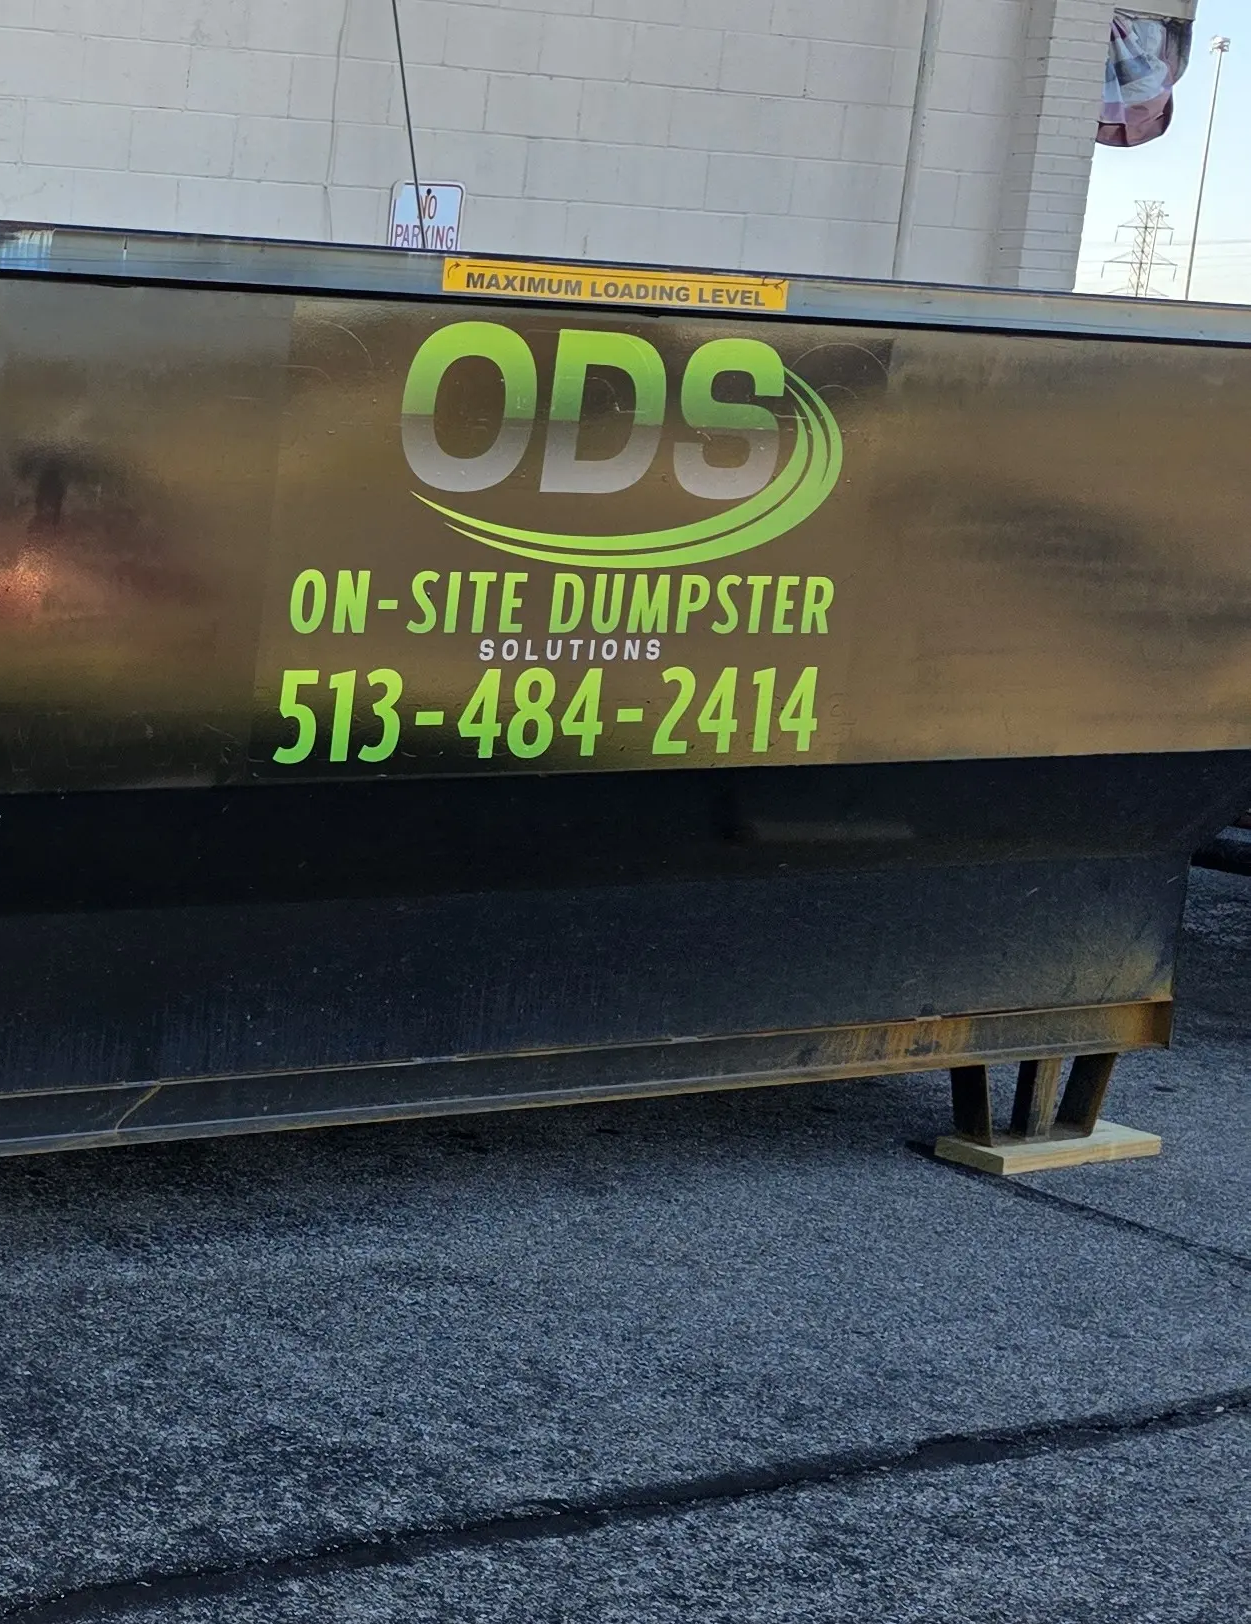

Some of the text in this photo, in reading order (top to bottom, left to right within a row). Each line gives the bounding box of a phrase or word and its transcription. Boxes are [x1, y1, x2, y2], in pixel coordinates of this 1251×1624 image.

[466, 272, 766, 307] MAXIMUM LOADING LEVEL
[401, 321, 785, 500] ODS
[290, 568, 835, 635] ON-SITE DUMPSTER
[478, 639, 661, 662] SOLUTIONS
[272, 665, 818, 765] 513-484-2414
